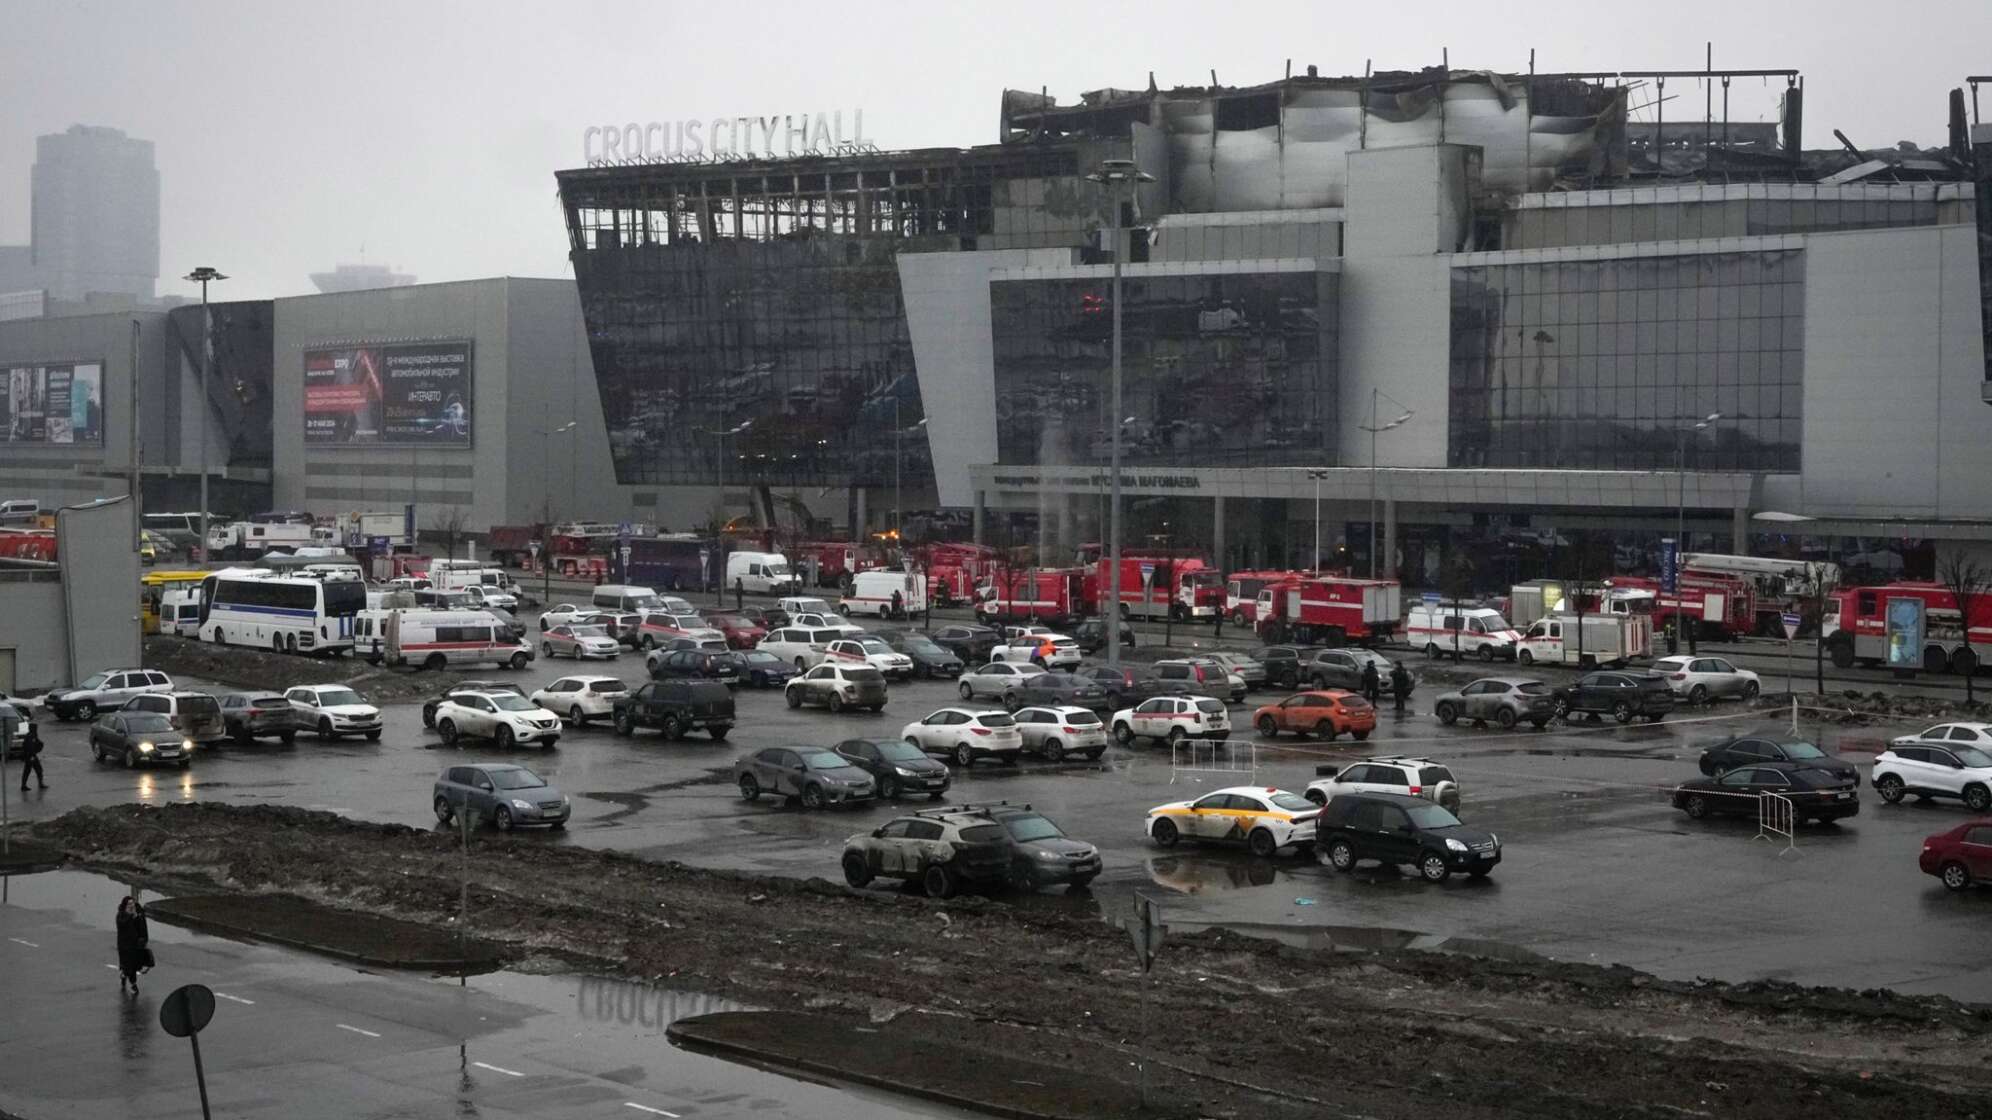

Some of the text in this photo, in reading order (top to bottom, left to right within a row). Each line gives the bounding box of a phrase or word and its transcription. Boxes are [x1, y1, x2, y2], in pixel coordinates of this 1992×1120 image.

[583, 108, 873, 162] CROCUS CITY HALL
